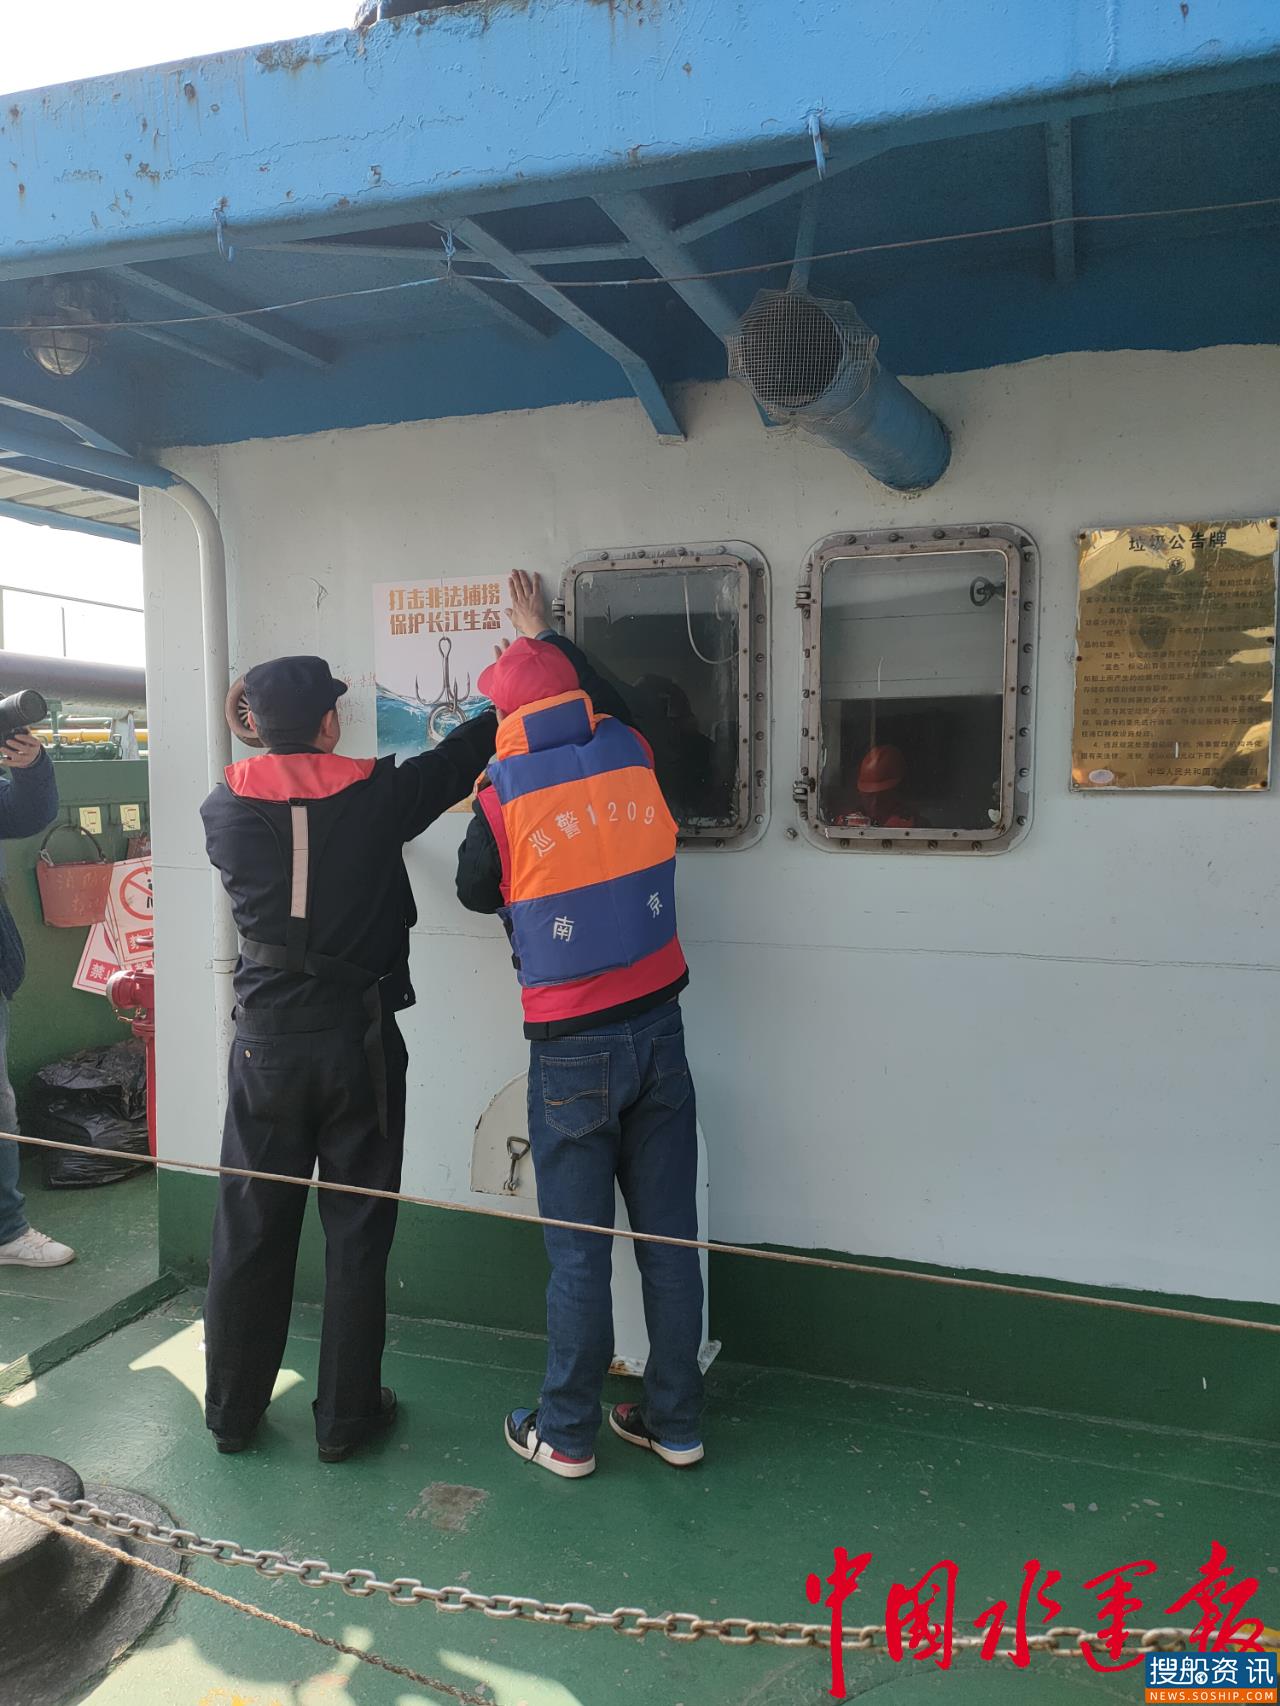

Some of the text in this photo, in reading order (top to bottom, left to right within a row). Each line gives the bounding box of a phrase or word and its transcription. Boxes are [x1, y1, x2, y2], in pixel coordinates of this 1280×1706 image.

[1128, 531, 1228, 552] 垃圾公告牌
[389, 583, 500, 611] 打击非法捕捞
[389, 608, 501, 636] 保护长江生态
[553, 891, 663, 942] 南 京
